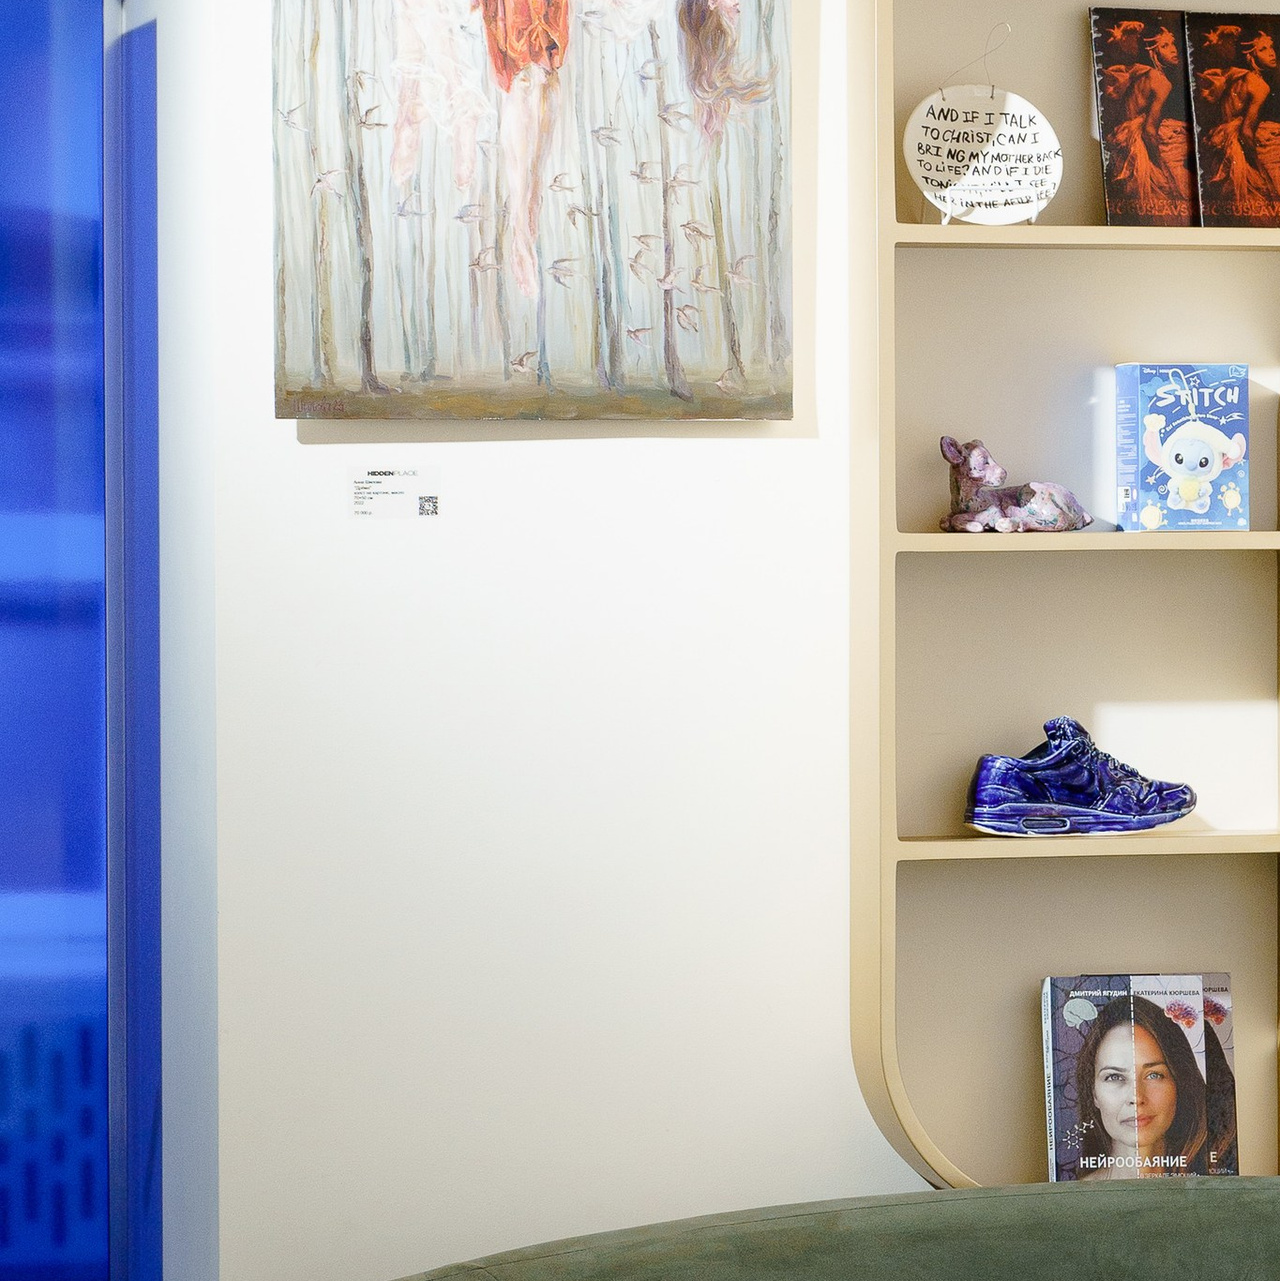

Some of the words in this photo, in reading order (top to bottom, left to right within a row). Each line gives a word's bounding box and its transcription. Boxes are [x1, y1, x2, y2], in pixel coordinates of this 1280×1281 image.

[926, 105, 959, 122] AND
[962, 111, 980, 123] IF
[984, 112, 995, 126] I
[1000, 112, 1037, 129] TALK
[921, 125, 940, 140] TO
[996, 133, 1027, 146] CAN
[1031, 132, 1040, 144] I
[968, 151, 989, 163] MY
[991, 152, 1034, 164] MOTHER
[1036, 148, 1062, 162] BACK
[917, 159, 932, 171] TO
[972, 165, 1002, 176] AND
[1022, 166, 1029, 175] I
[1034, 164, 1052, 175] DIE
[1156, 384, 1239, 408] STITCH
[1080, 1153, 1187, 1169] НЕЙРООБАЯНИЕ
